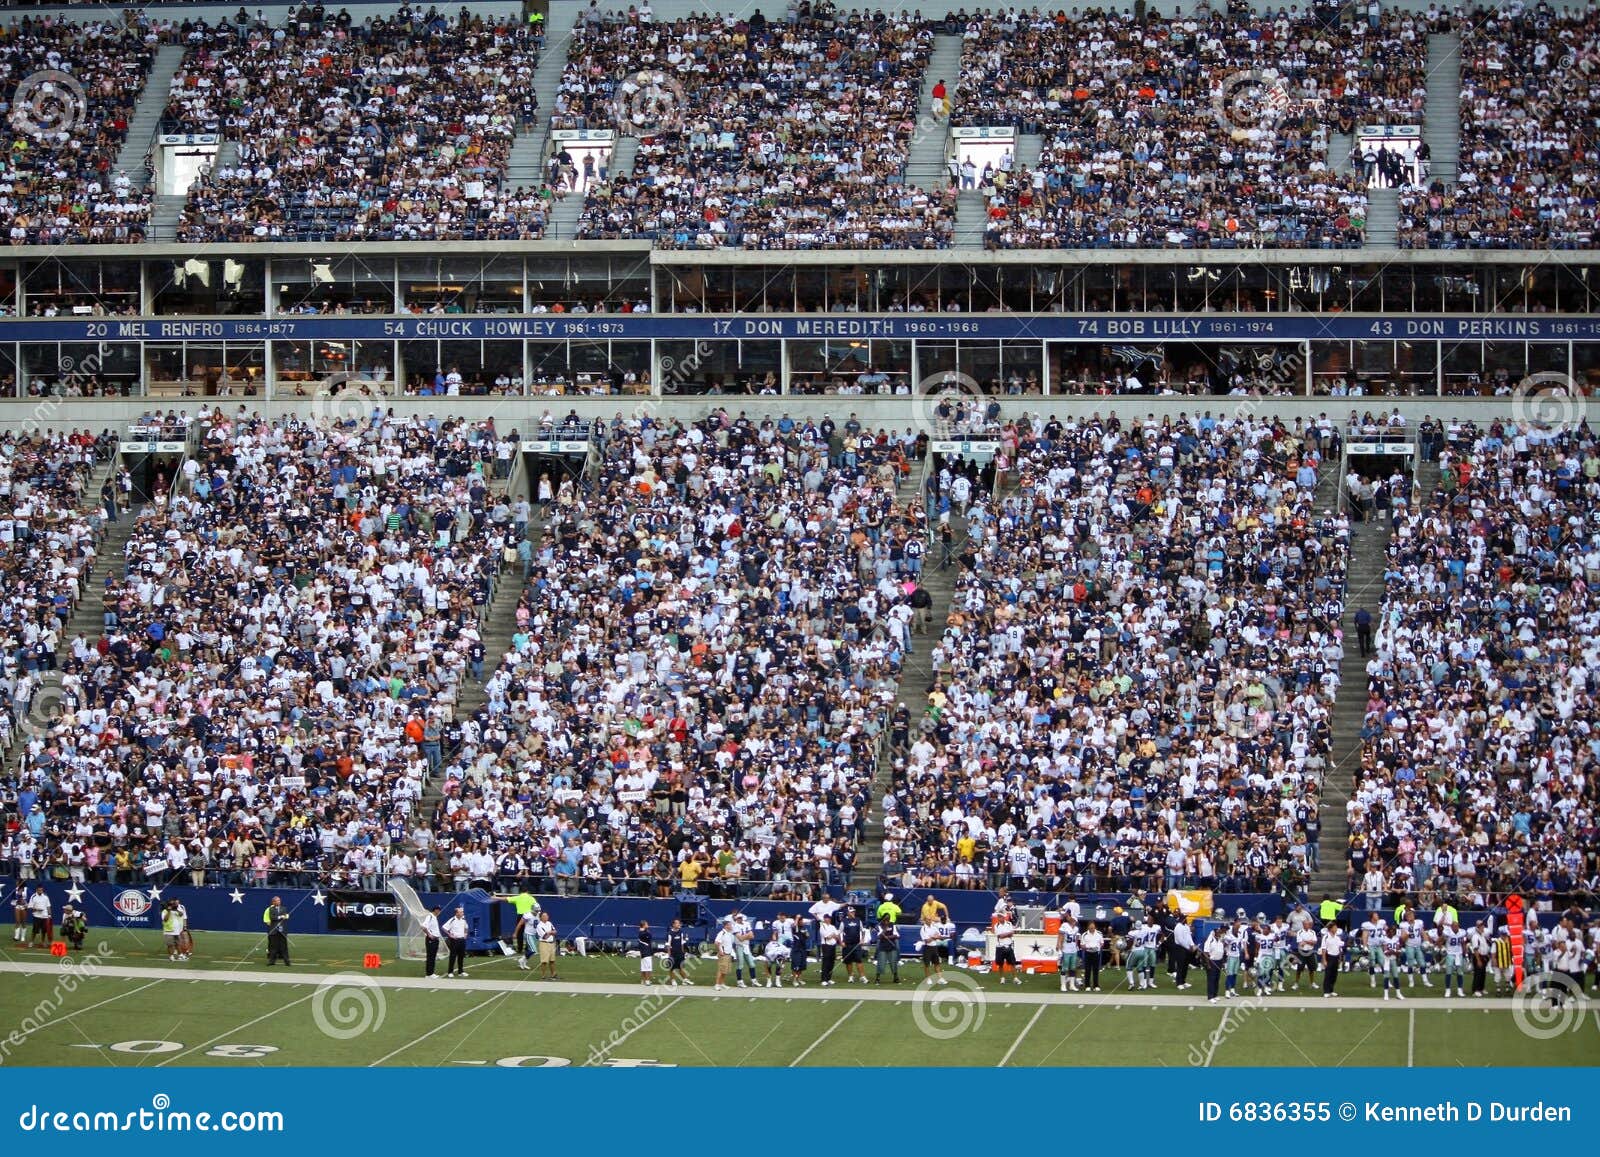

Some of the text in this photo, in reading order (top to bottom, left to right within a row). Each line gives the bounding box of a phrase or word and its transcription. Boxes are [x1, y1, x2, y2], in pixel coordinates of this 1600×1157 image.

[86, 322, 295, 337] 20 MEL RENFRO 1964-1977
[384, 321, 625, 336] 54 CHUCK HOWLEY 1961-1973
[712, 320, 979, 335] 17 DON MEREDITH 1960-1968
[1078, 320, 1274, 335] 74 BOB LILLY 1961-1974
[1370, 321, 1393, 335] 43
[1407, 320, 1444, 335] DON
[1458, 320, 1541, 335] PERKINS
[908, 545, 919, 554] 24
[1329, 605, 1339, 614] 24
[1042, 679, 1053, 688] 94
[1015, 852, 1027, 862] 82
[1253, 857, 1262, 867] 81
[504, 859, 516, 870] 31
[124, 896, 141, 910] NFL
[336, 904, 401, 915] NFL CBS
[1260, 939, 1273, 949] 23
[51, 943, 64, 957] 20
[365, 955, 378, 967] 30
